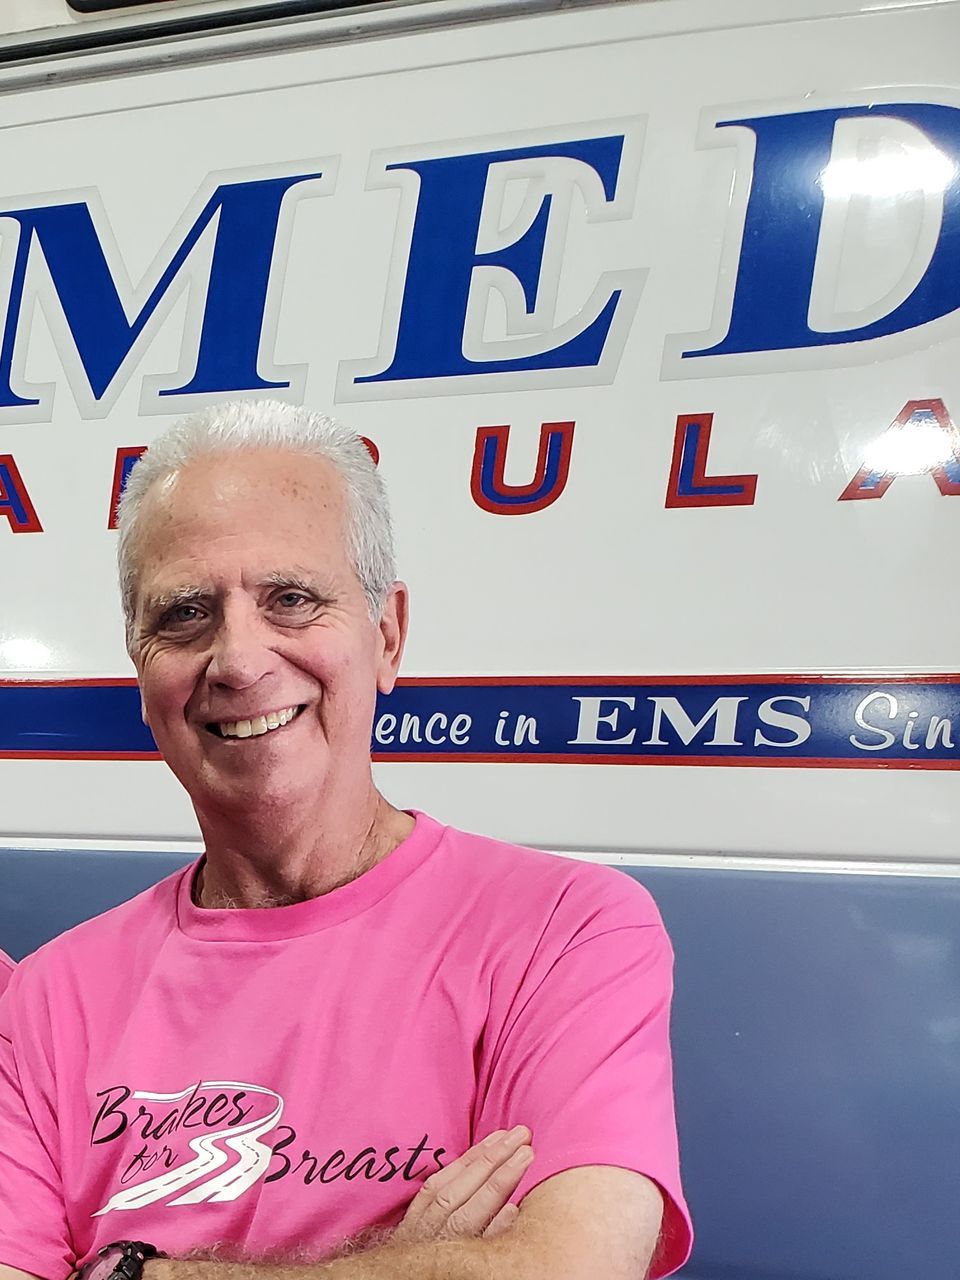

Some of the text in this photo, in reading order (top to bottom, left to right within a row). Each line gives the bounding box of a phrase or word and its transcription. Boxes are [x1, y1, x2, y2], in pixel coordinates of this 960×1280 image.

[495, 710, 540, 746] in
[567, 695, 812, 748] EMS
[849, 692, 955, 752] Sin
[91, 1080, 254, 1147] Brakes
[121, 1143, 179, 1185] for
